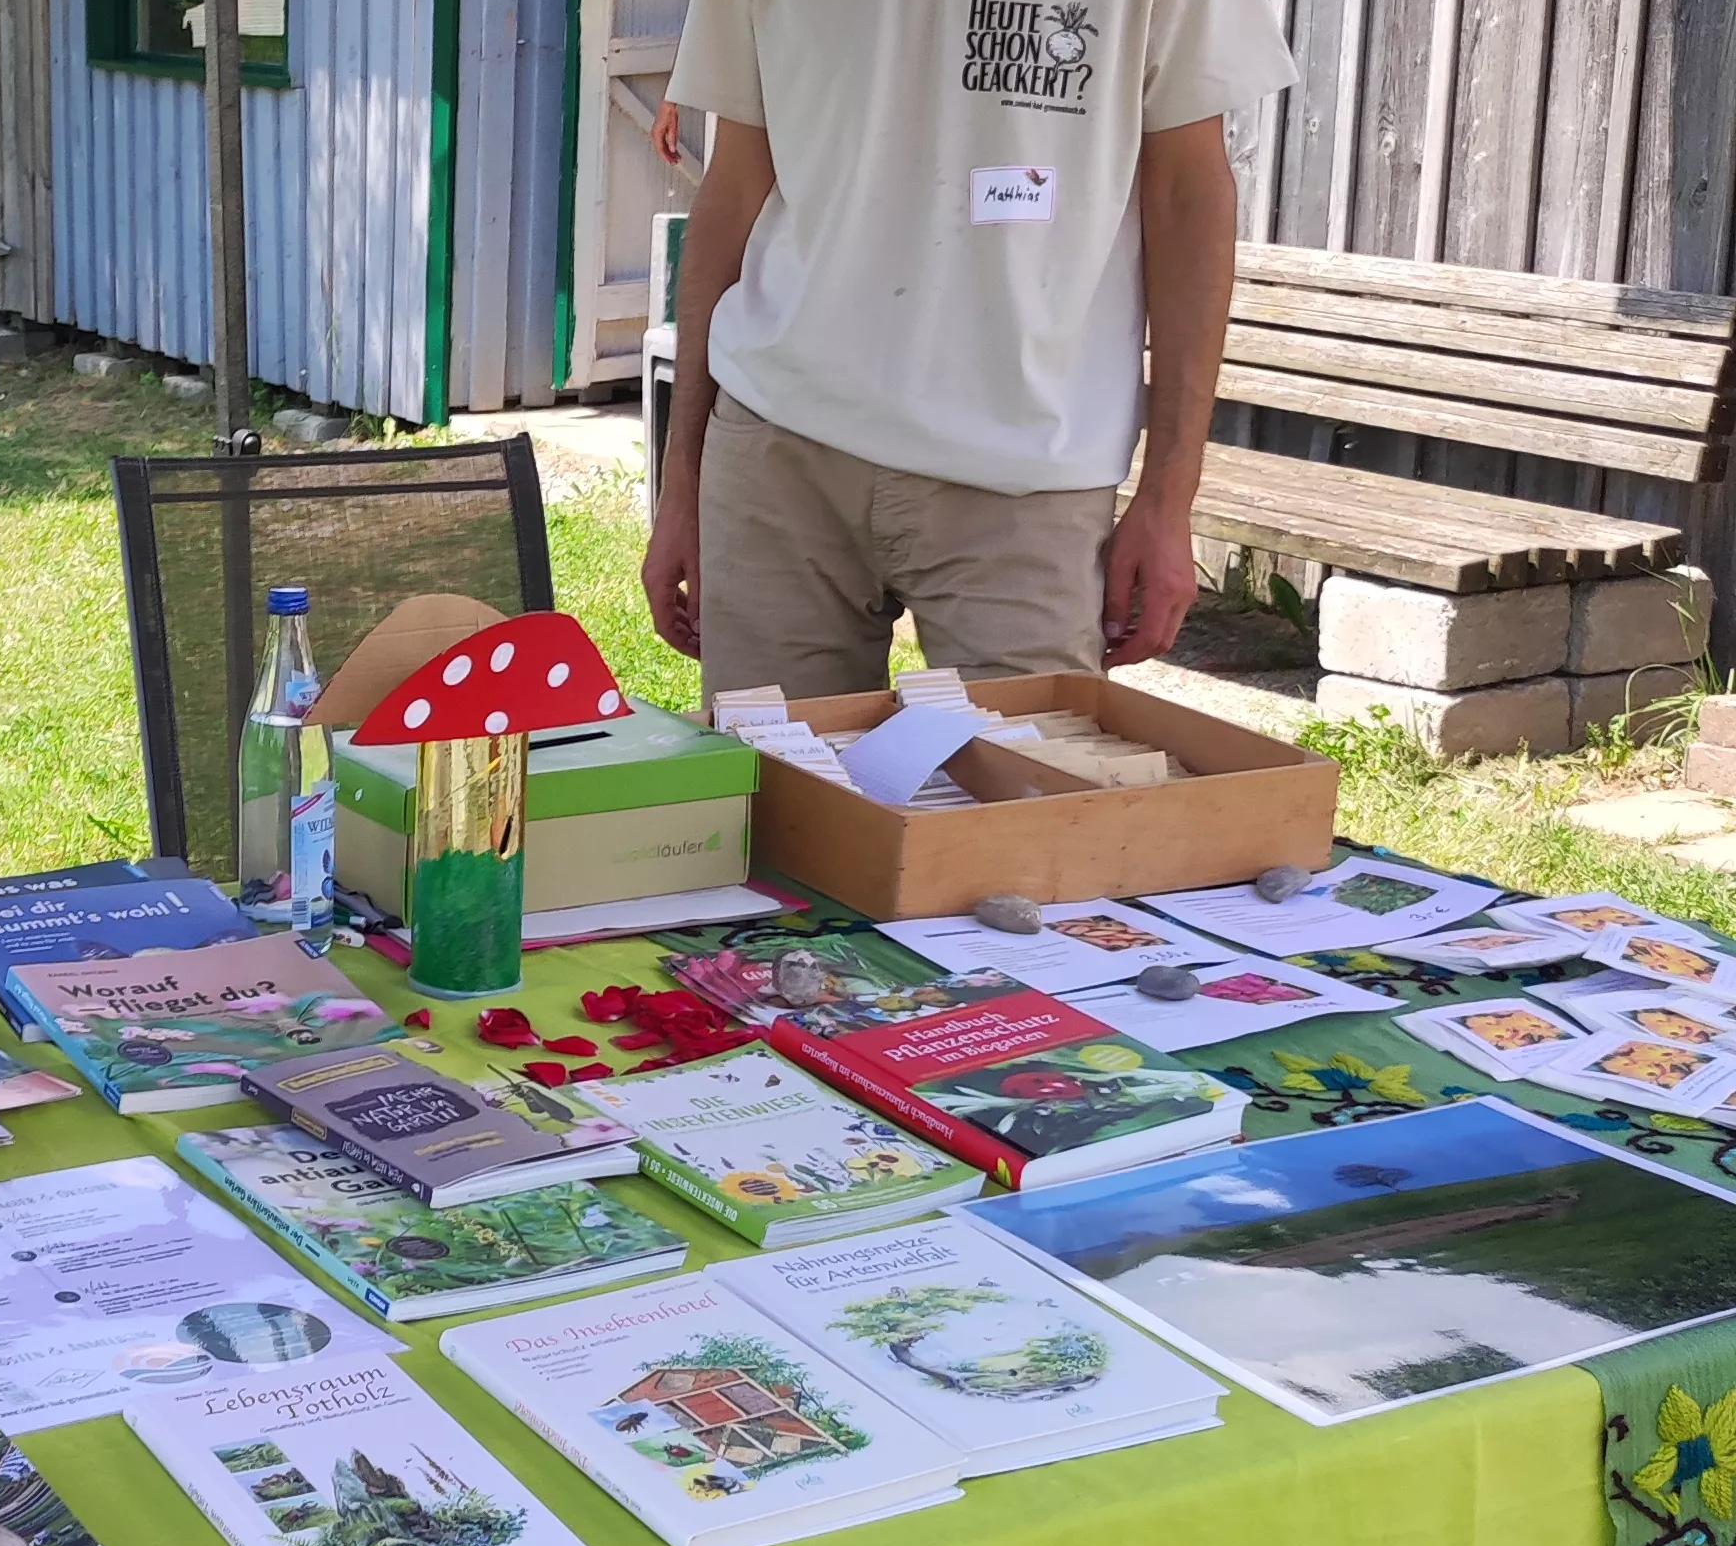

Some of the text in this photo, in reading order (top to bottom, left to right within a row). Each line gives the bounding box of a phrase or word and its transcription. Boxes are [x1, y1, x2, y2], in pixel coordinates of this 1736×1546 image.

[964, 31, 1042, 64] SCHON
[962, 61, 1093, 100] GEACKERT?
[984, 185, 1040, 203] Matthias
[23, 876, 79, 890] was
[28, 899, 68, 915] dir
[106, 891, 191, 922] wohl!
[57, 975, 181, 999] Worauf
[106, 980, 277, 1015] fliegst du?
[882, 1012, 1061, 1064] Pflanzenschutz
[903, 1011, 1009, 1043] Handbuch
[931, 1029, 1051, 1065] im Biogarten
[645, 1092, 816, 1132] INSEKTENWIESE
[689, 1095, 730, 1111] DIE
[286, 1149, 342, 1165] De
[723, 1205, 738, 1222] DIE
[772, 1236, 933, 1275] Nahrungsnetze
[785, 1275, 820, 1290] für
[827, 1247, 958, 1282] Artenvielfalt
[505, 1334, 560, 1354] Das
[563, 1289, 718, 1340] Insektenhotel
[204, 1367, 387, 1417] Lebensraum
[276, 1382, 396, 1420] Totholz
